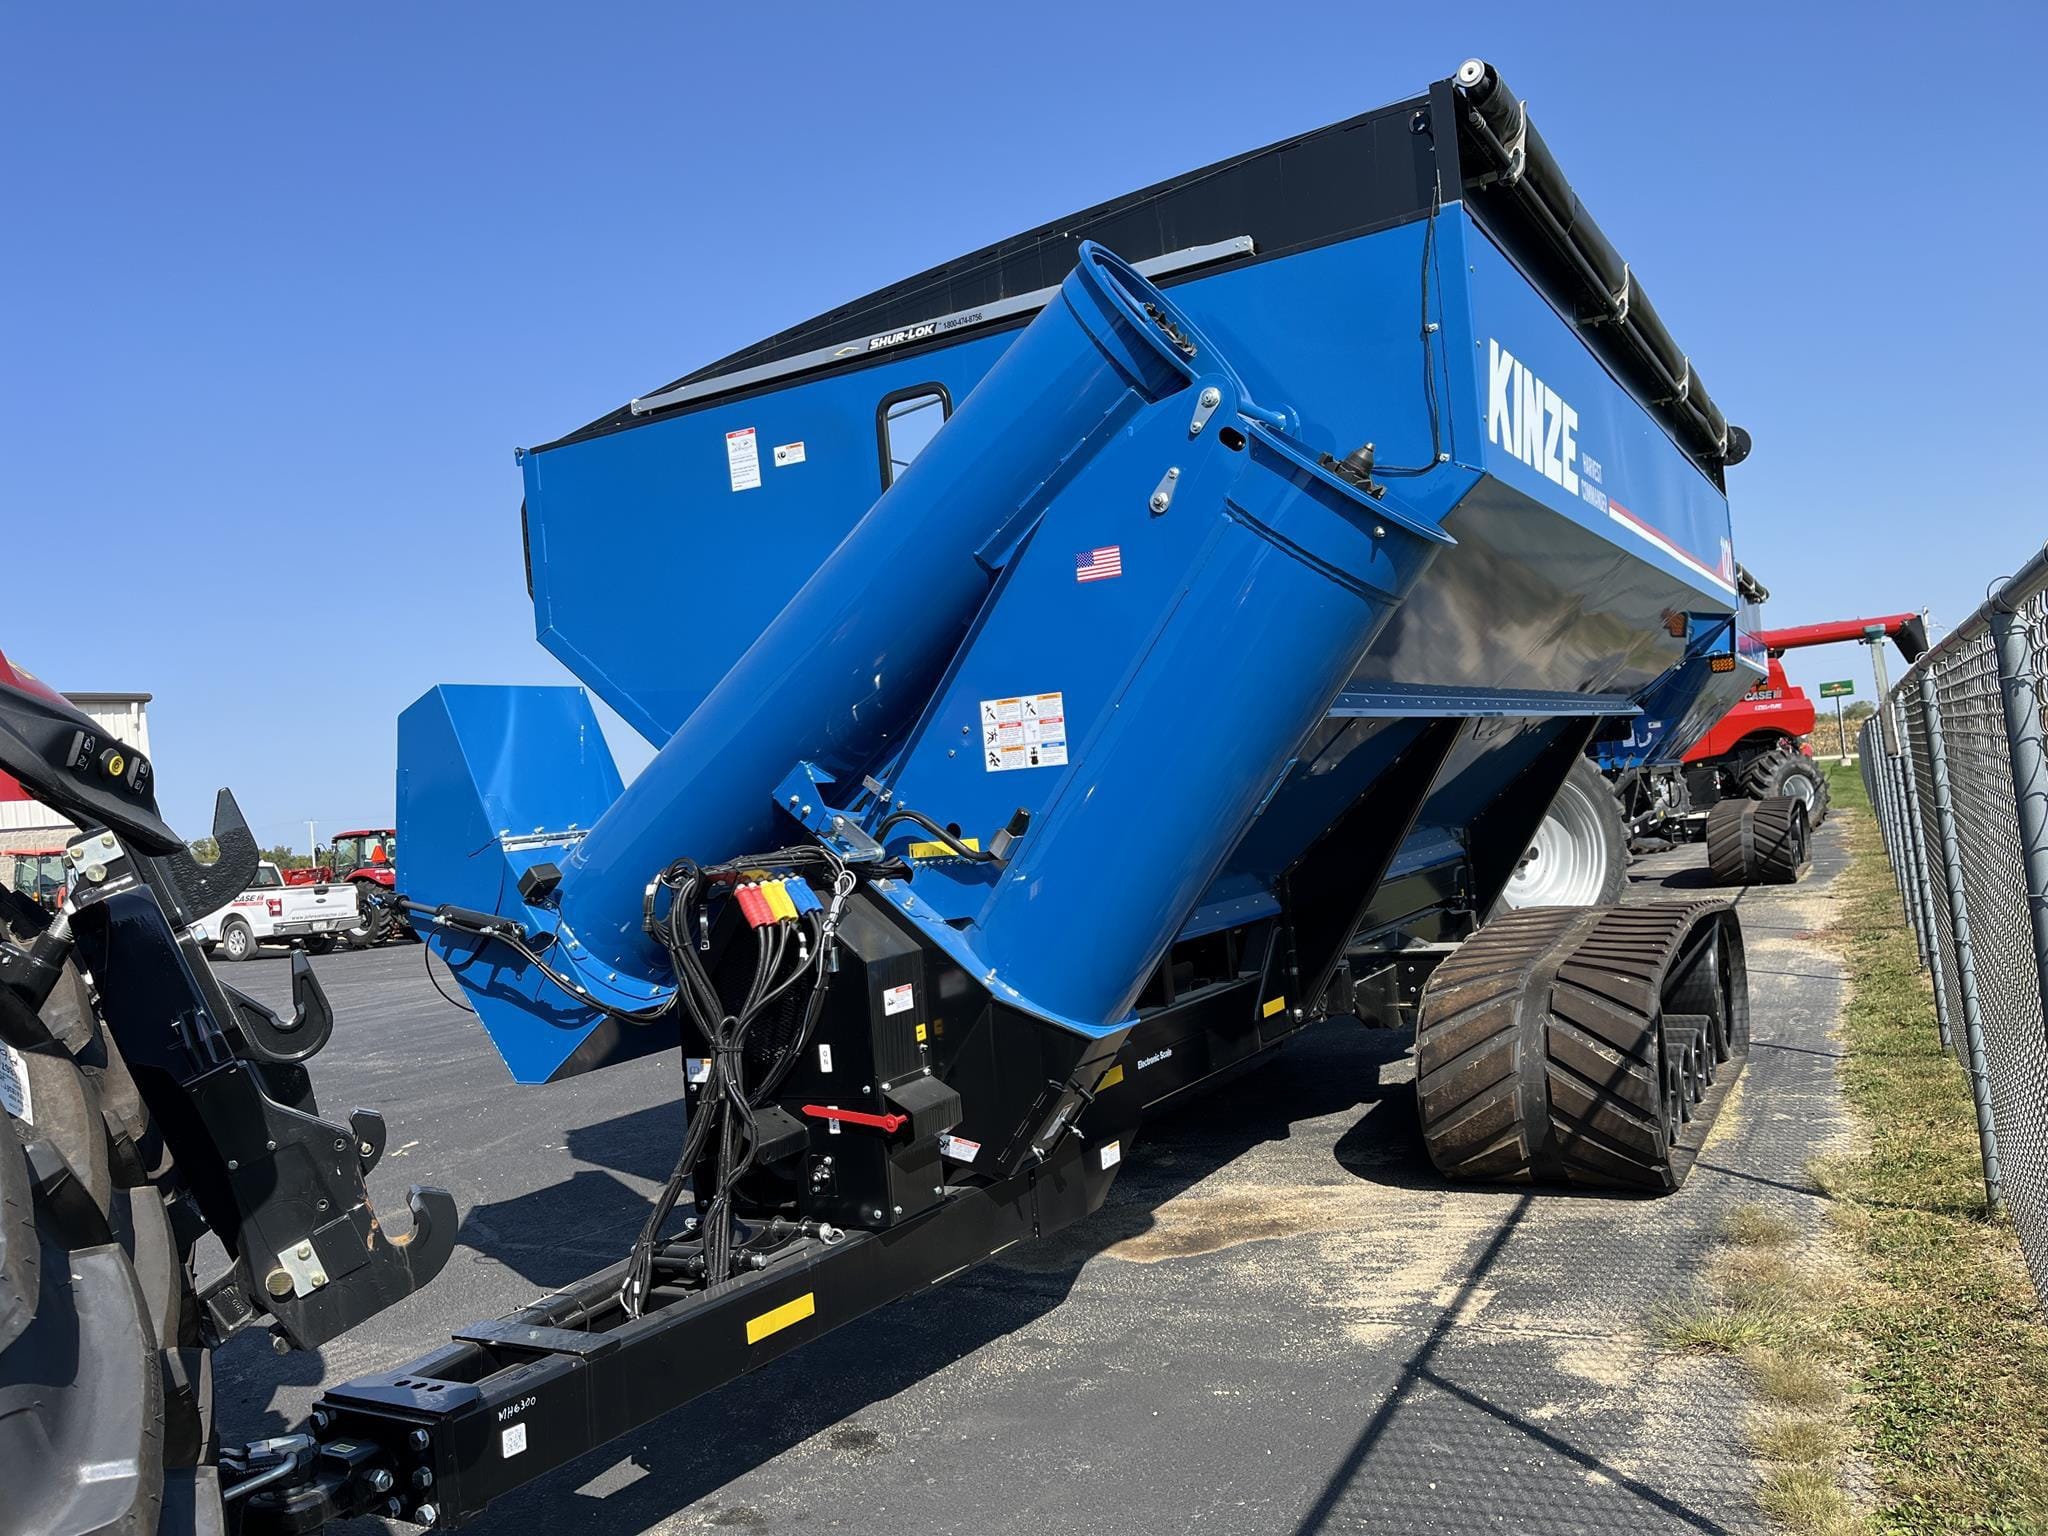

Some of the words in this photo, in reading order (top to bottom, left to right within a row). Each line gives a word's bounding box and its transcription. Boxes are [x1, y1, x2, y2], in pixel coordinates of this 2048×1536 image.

[869, 322, 936, 350] SHUR-LOK
[1488, 338, 1579, 497] KINZE
[1744, 690, 1773, 702] CASE
[233, 894, 257, 904] CASE
[1137, 1053, 1160, 1070] Electronic
[1159, 1048, 1173, 1060] Scale
[498, 1396, 537, 1422] MH6300
